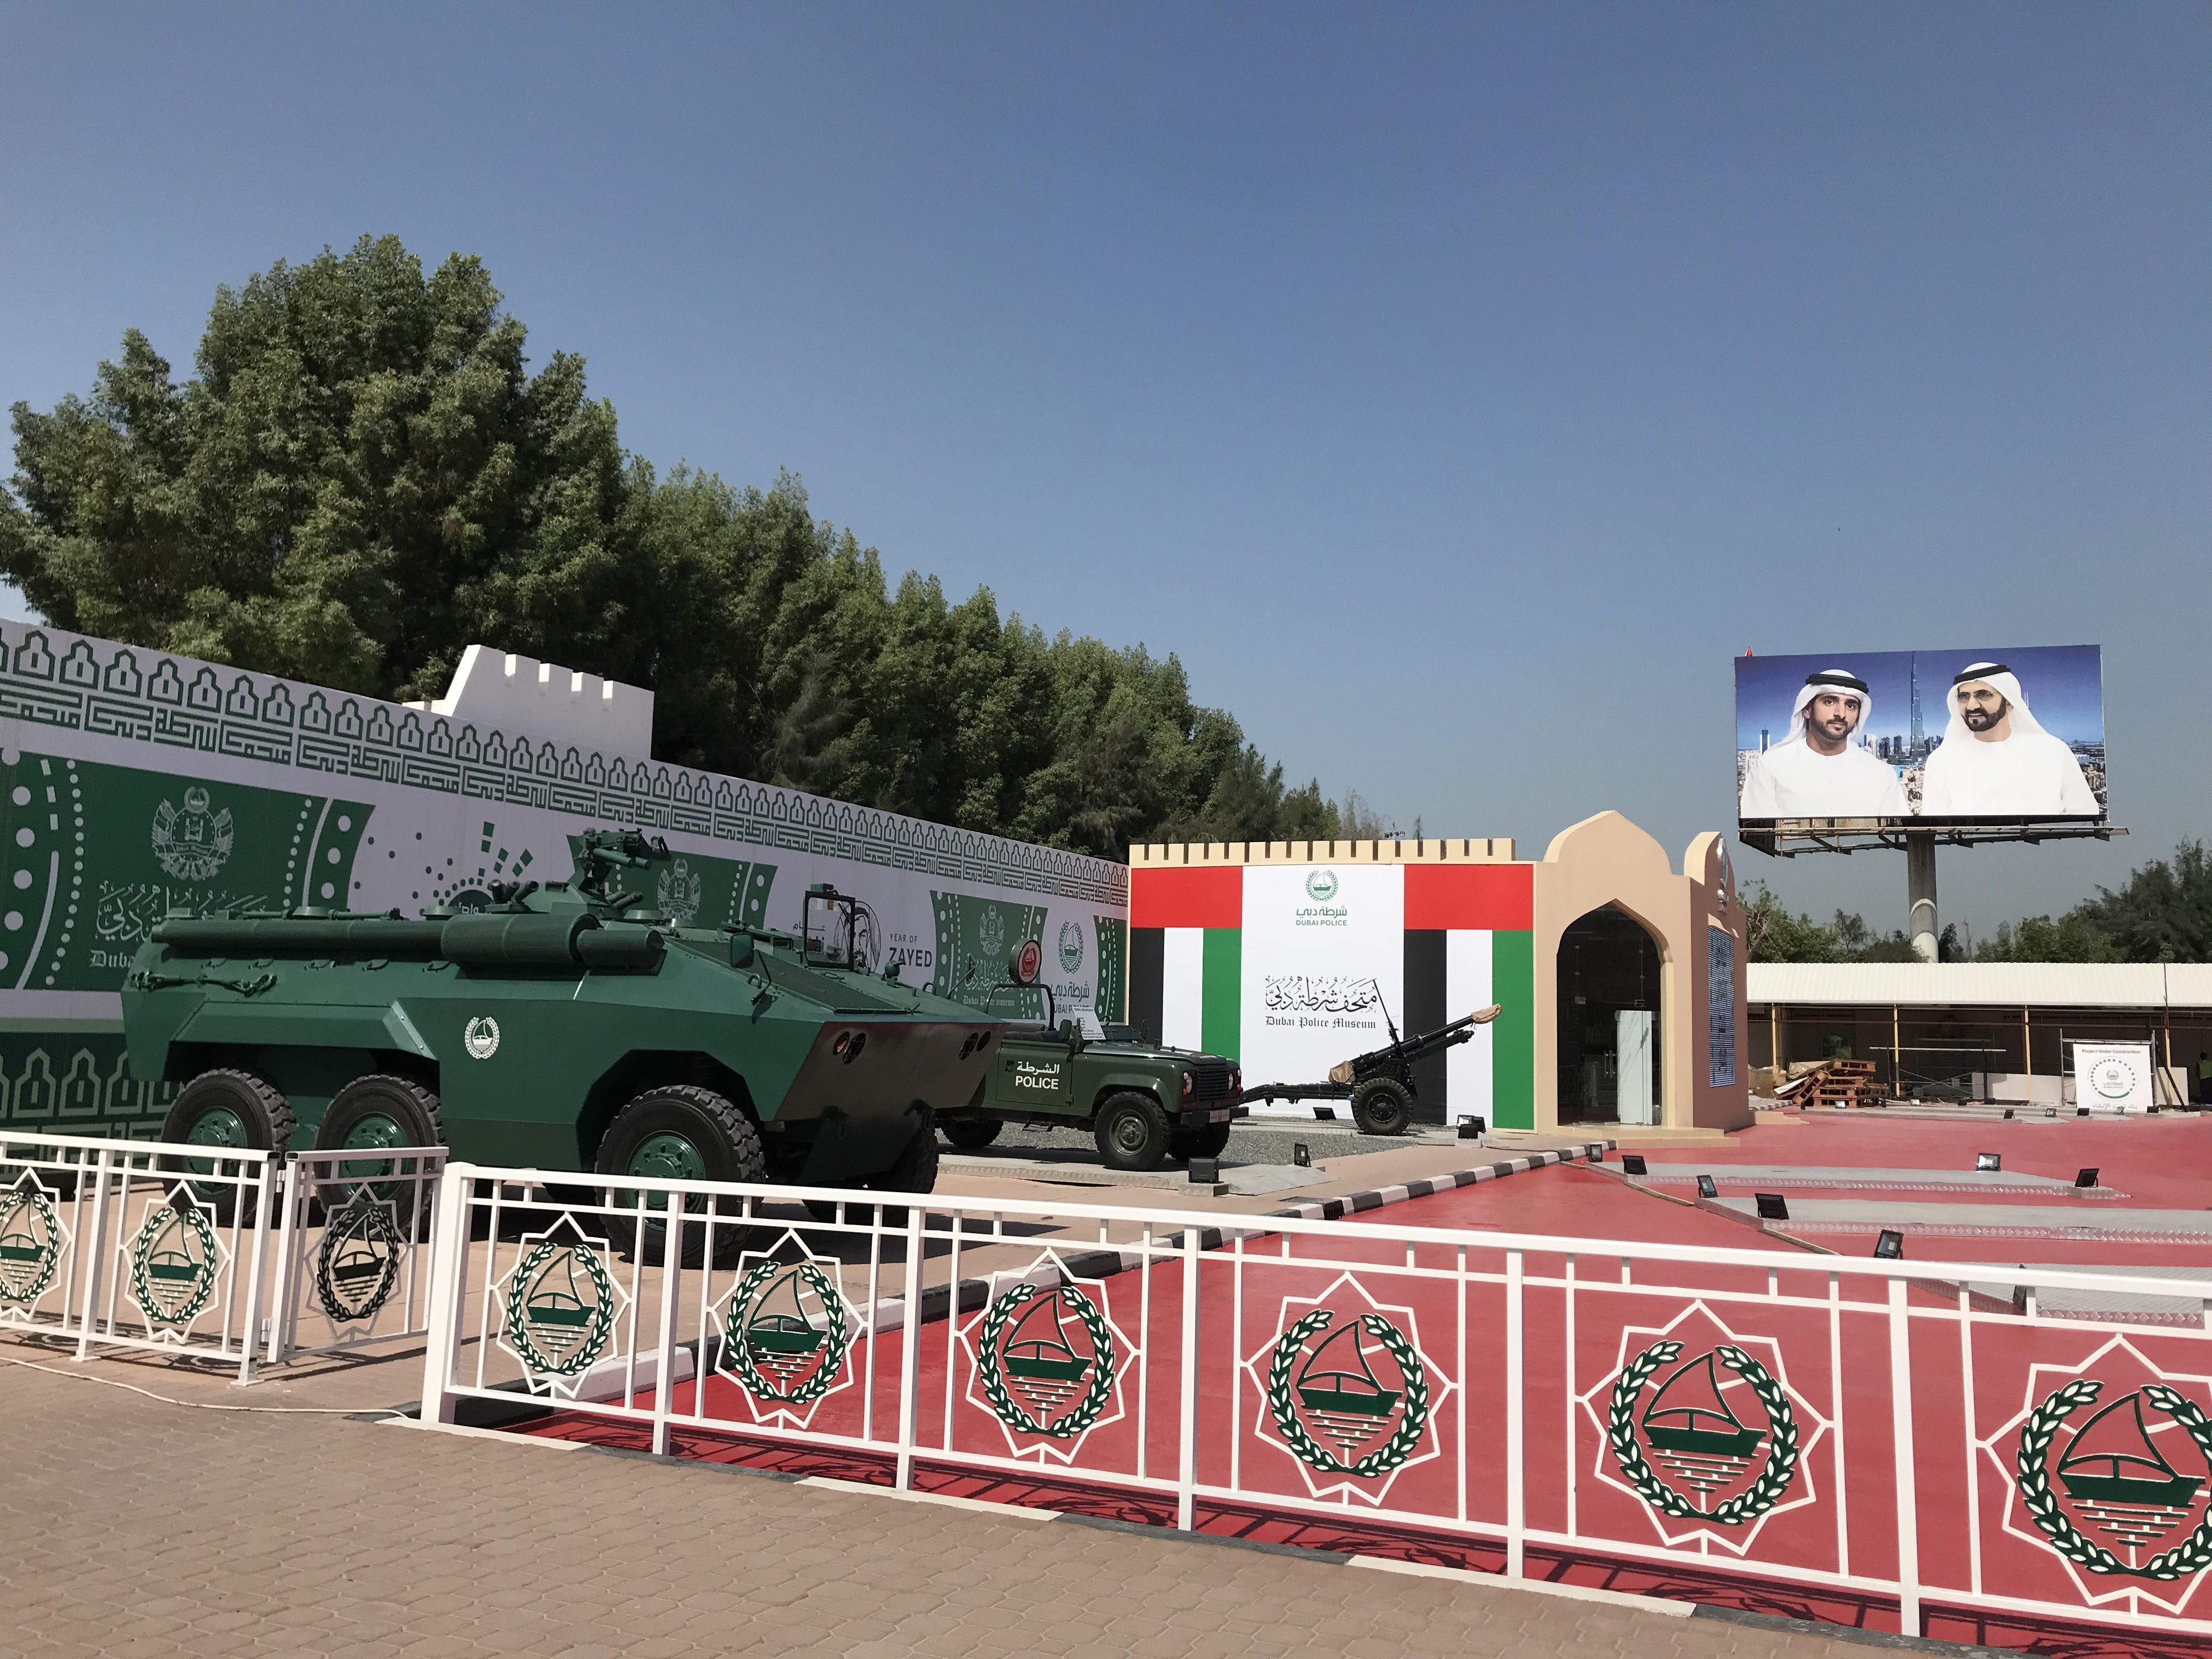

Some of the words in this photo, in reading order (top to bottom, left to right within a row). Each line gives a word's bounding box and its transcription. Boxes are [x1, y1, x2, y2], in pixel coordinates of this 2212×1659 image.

[1296, 908, 1318, 918] دبي
[1318, 905, 1347, 918] شرطة
[889, 933, 907, 942] YEAR
[909, 935, 918, 943] OF
[889, 947, 933, 967] ZAYED
[1051, 984, 1067, 1001] دبي
[1068, 980, 1090, 1002] شرطة
[1325, 978, 1378, 1013] متحف
[1054, 1004, 1068, 1013] UBAI
[1265, 1015, 1295, 1026] Dubai
[1299, 1016, 1329, 1028] Police
[1331, 1017, 1376, 1029] Museum
[1017, 1061, 1060, 1075] الشرطة
[1015, 1075, 1059, 1090] POLICE
